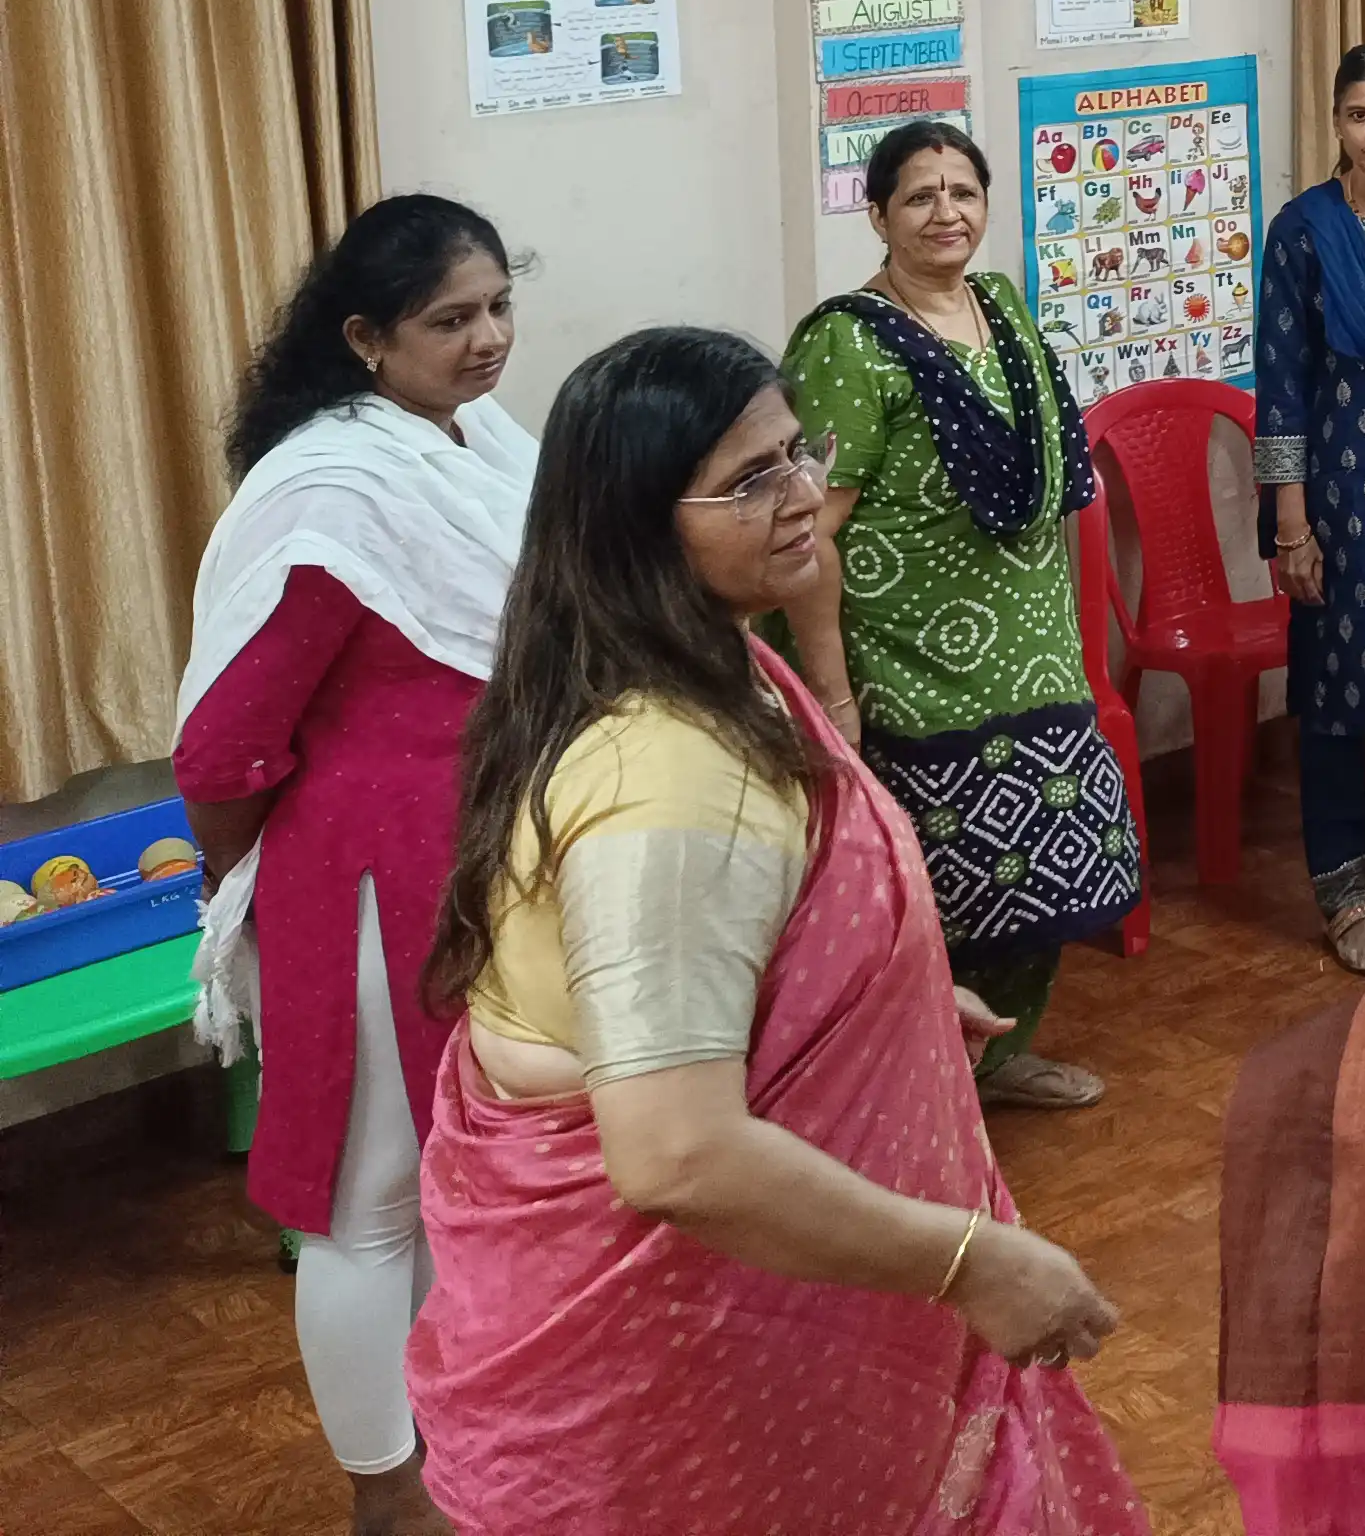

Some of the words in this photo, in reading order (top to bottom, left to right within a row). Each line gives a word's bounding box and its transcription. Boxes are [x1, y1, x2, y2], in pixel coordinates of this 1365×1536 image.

[843, 39, 949, 73] SEPTEMBER
[846, 90, 931, 117] OCTOBER
[1077, 83, 1205, 112] ALPHABET
[1036, 130, 1063, 146] Aa
[1082, 123, 1109, 140] Bb
[1127, 120, 1153, 135] Cc
[1170, 113, 1193, 130] Dd
[1211, 110, 1232, 125] Ee
[1037, 186, 1057, 203] Ff
[1084, 180, 1111, 198] Gg
[1128, 174, 1153, 191] Hh
[1212, 164, 1229, 182] Jj
[1039, 241, 1066, 260] Kk
[1129, 231, 1161, 246] Mm
[1171, 225, 1196, 240] Nn
[1214, 220, 1238, 234] Oo
[1040, 301, 1066, 318] Pp
[1086, 294, 1112, 311] Qq
[1130, 285, 1152, 302] Rr
[1172, 280, 1196, 295] Ss
[1215, 272, 1235, 288] Tt
[1080, 349, 1105, 367] Vv
[1117, 343, 1150, 360] Ww
[1154, 337, 1178, 352] Xx
[1190, 330, 1212, 348] Yy
[1222, 326, 1242, 340] Zz
